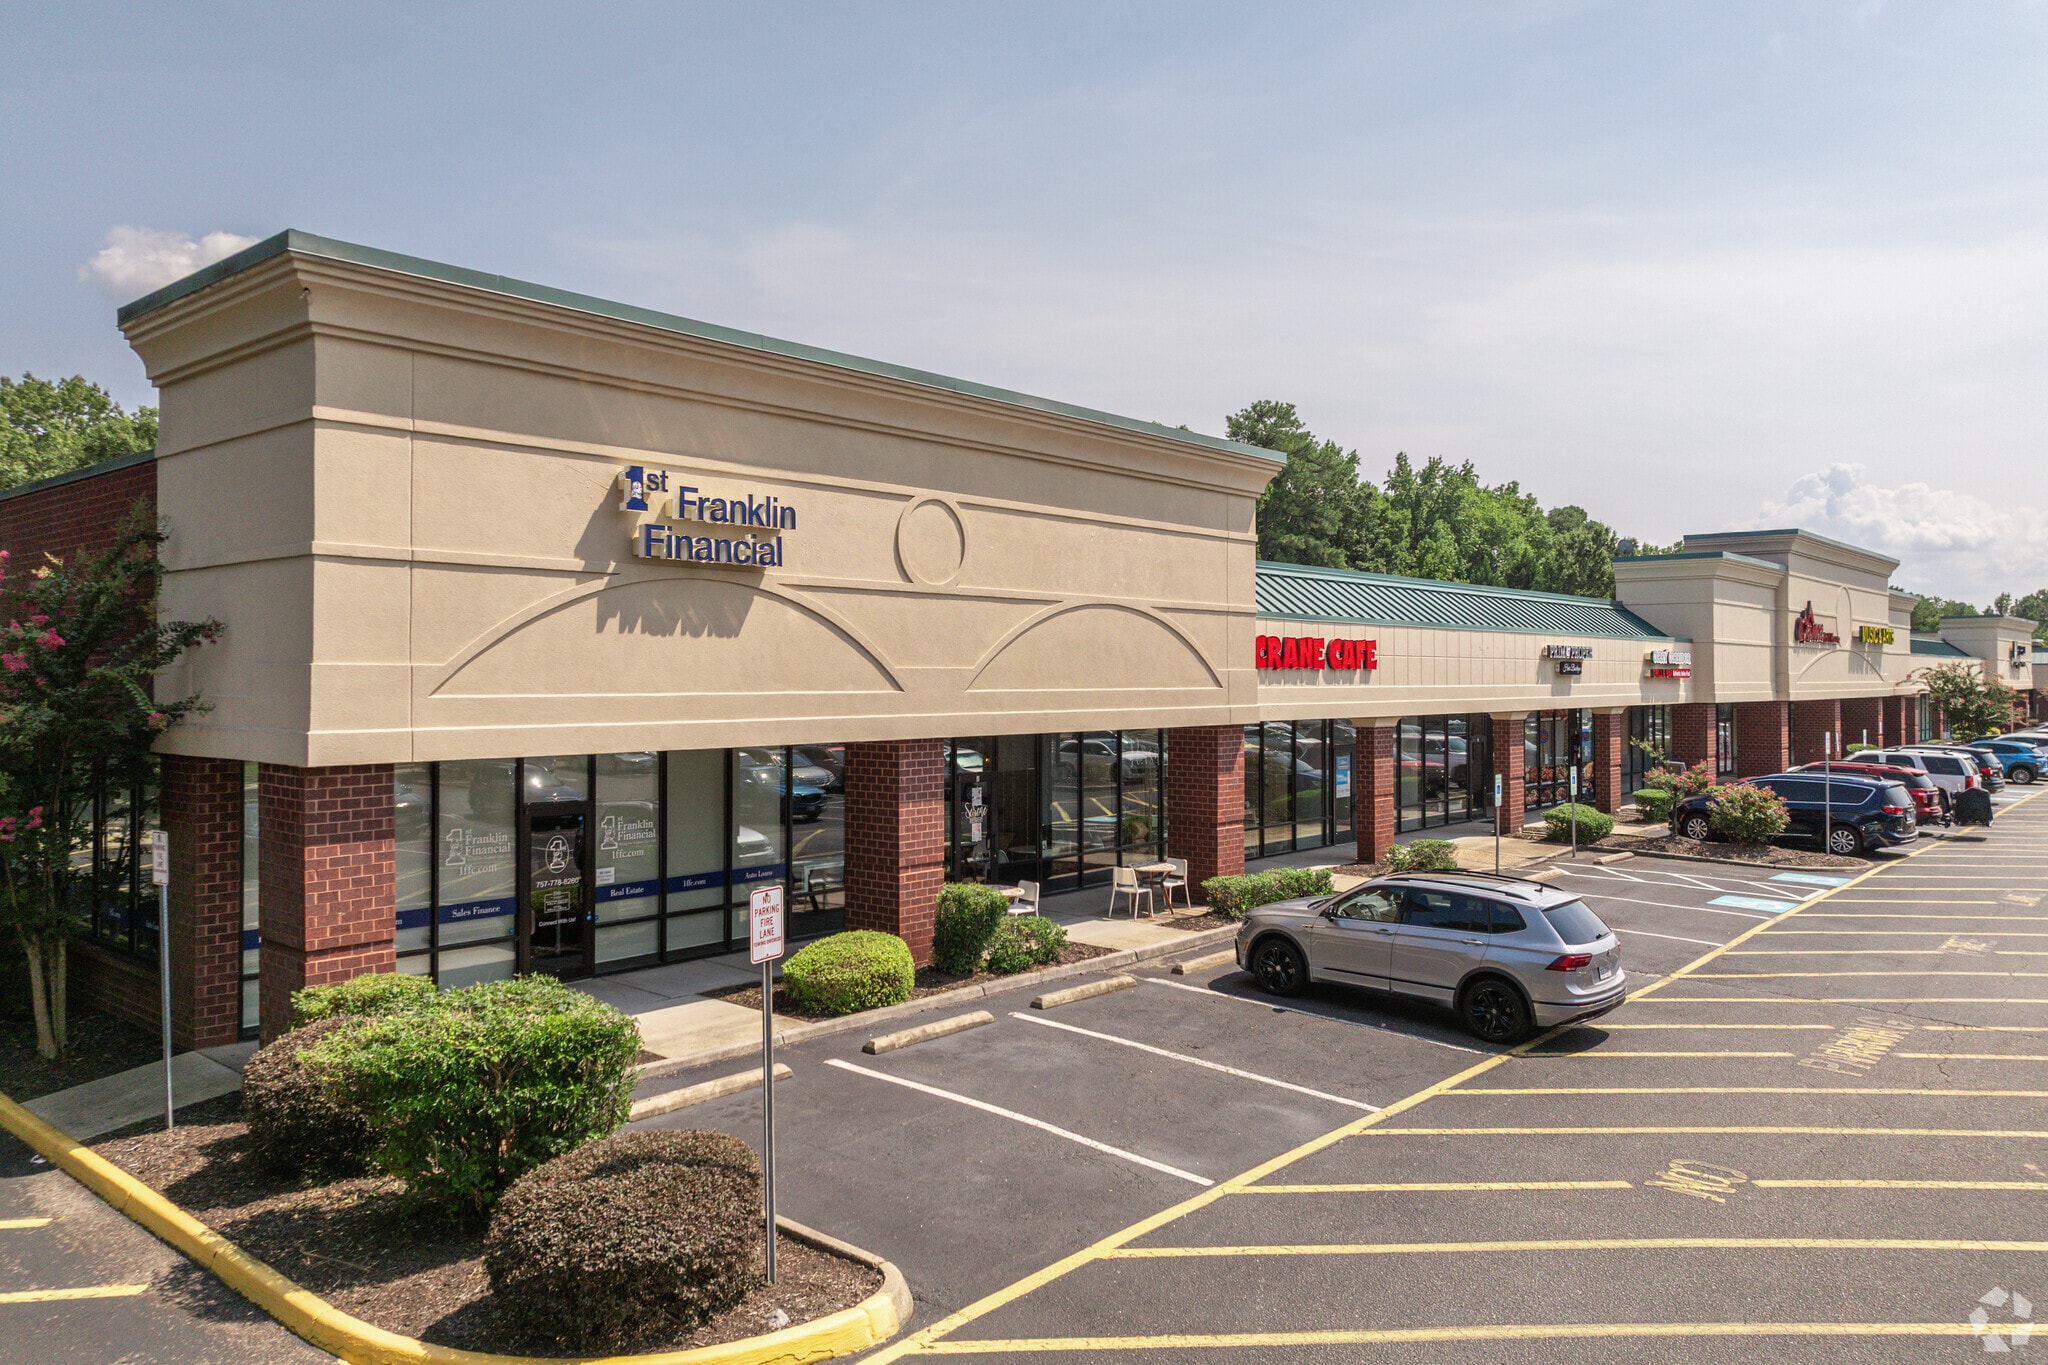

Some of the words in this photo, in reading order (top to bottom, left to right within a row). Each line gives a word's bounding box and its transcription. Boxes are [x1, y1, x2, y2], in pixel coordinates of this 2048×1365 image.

[625, 466, 669, 511] 1st
[678, 486, 796, 530] Franklin
[644, 523, 783, 567] Financial
[1256, 635, 1325, 670] CRANE
[1326, 638, 1377, 670] CAFE
[617, 820, 654, 831] Franklin
[465, 832, 508, 846] Franklin
[617, 829, 656, 841] Financial
[465, 842, 511, 856] Financial
[762, 895, 771, 904] NO
[452, 910, 471, 918] Sales
[473, 906, 501, 914] Finance
[754, 904, 780, 917] PARKING
[760, 917, 773, 928] FIRE
[759, 927, 774, 939] LANE
